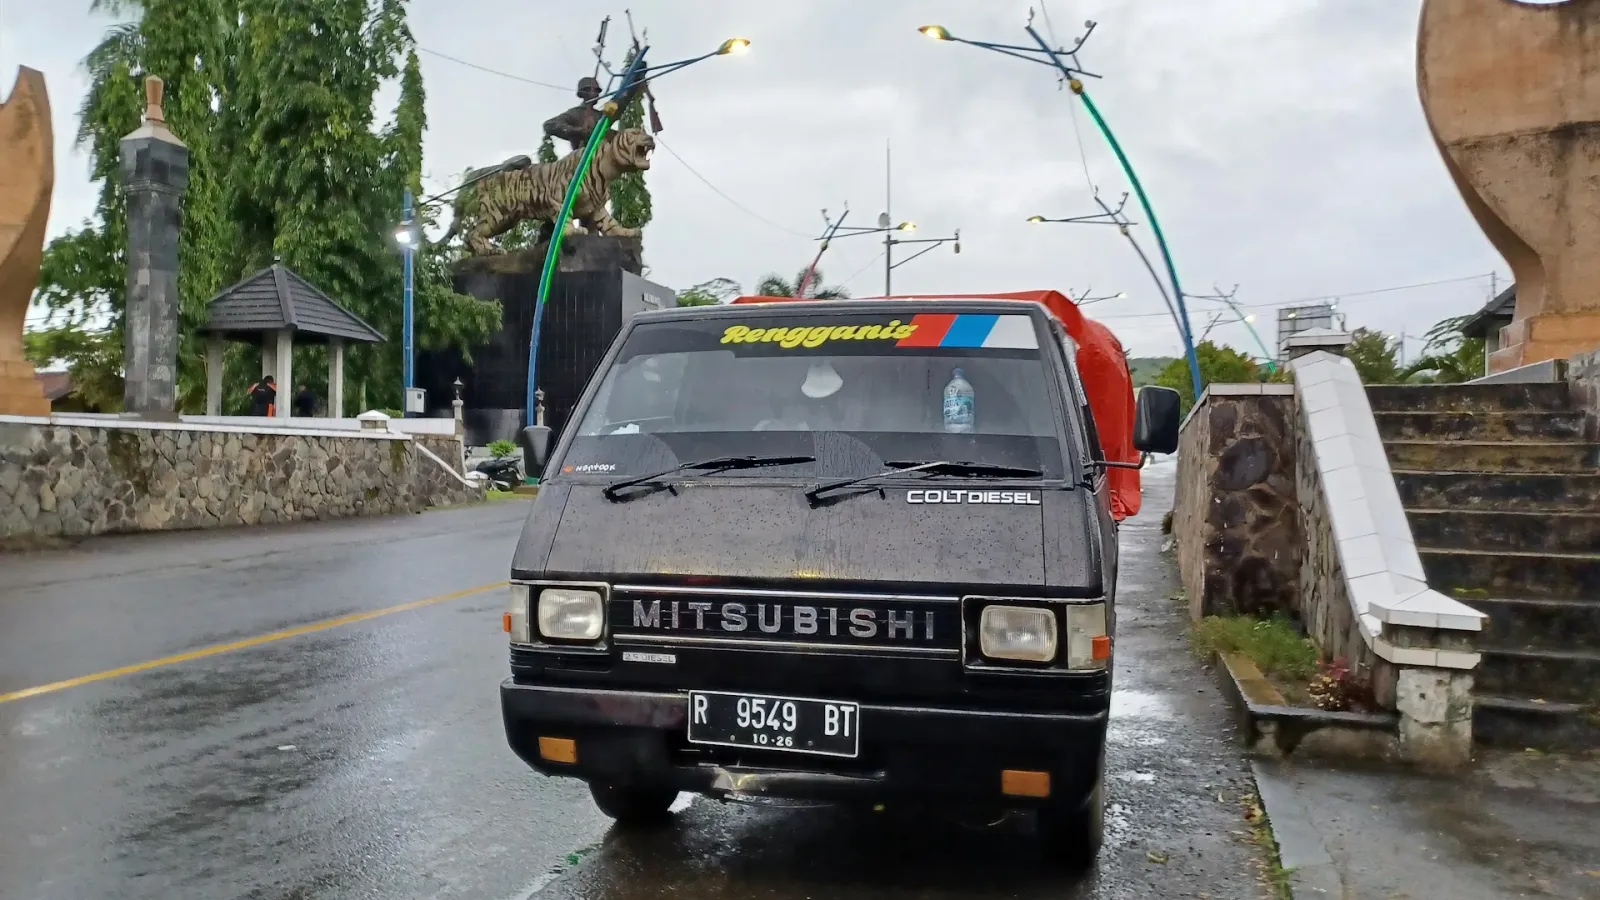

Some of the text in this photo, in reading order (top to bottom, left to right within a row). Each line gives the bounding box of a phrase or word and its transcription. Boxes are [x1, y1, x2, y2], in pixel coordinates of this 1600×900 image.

[720, 319, 919, 348] Rengganis
[633, 599, 935, 640] MITSUBISHI
[694, 694, 855, 737] R 9549 BT
